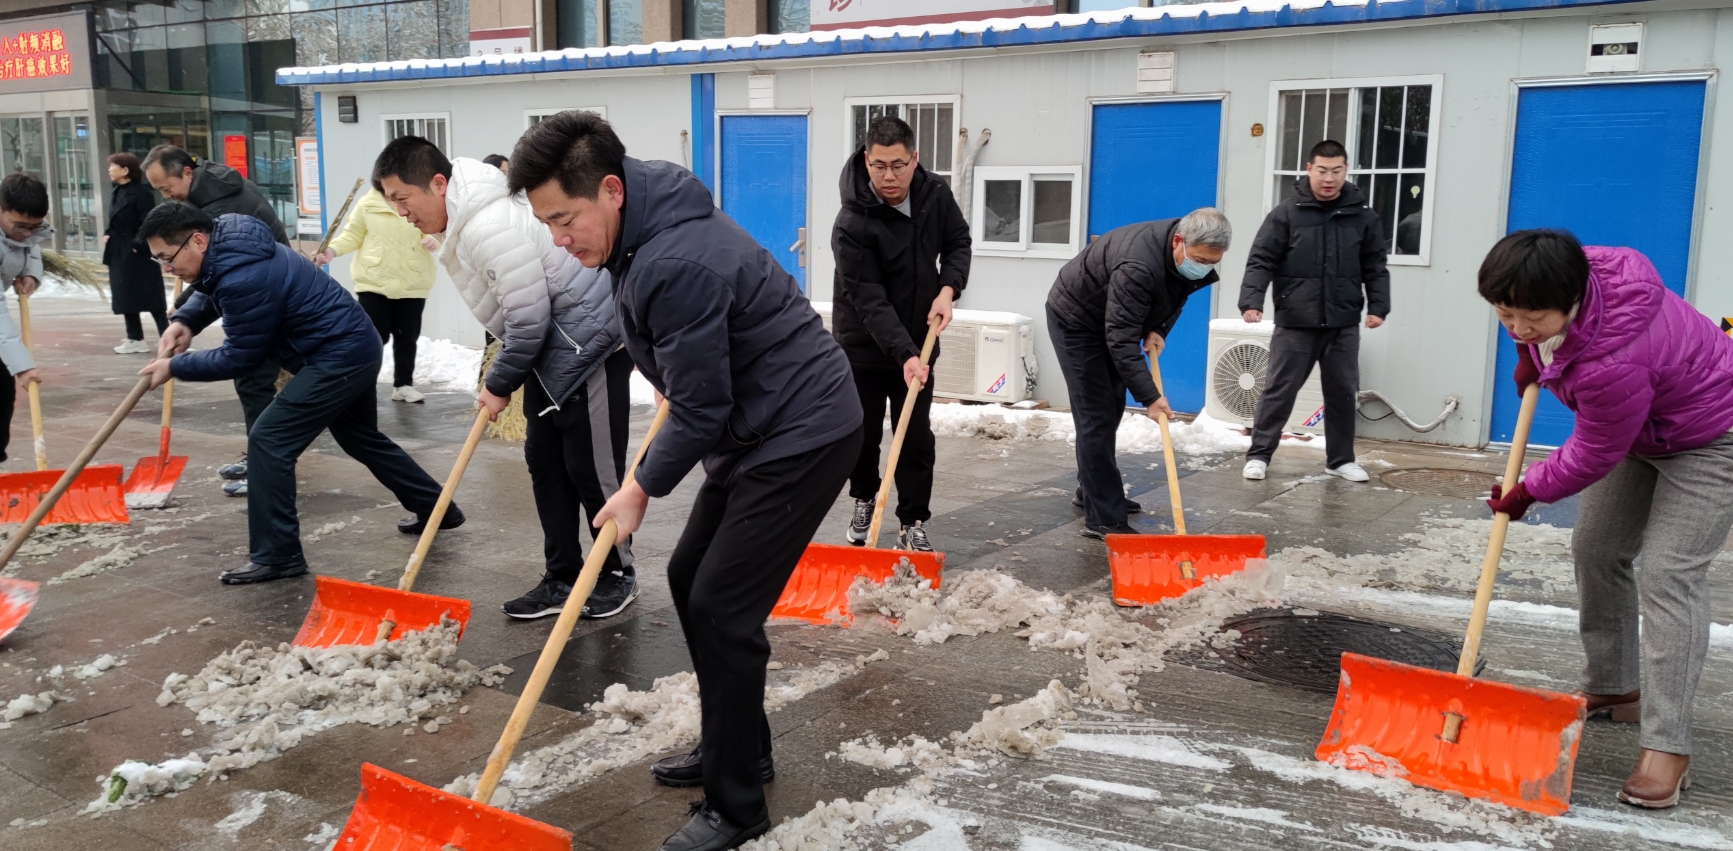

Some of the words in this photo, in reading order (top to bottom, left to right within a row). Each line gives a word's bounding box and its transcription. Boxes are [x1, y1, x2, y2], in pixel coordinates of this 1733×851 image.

[0, 29, 64, 55] 入+射频消融
